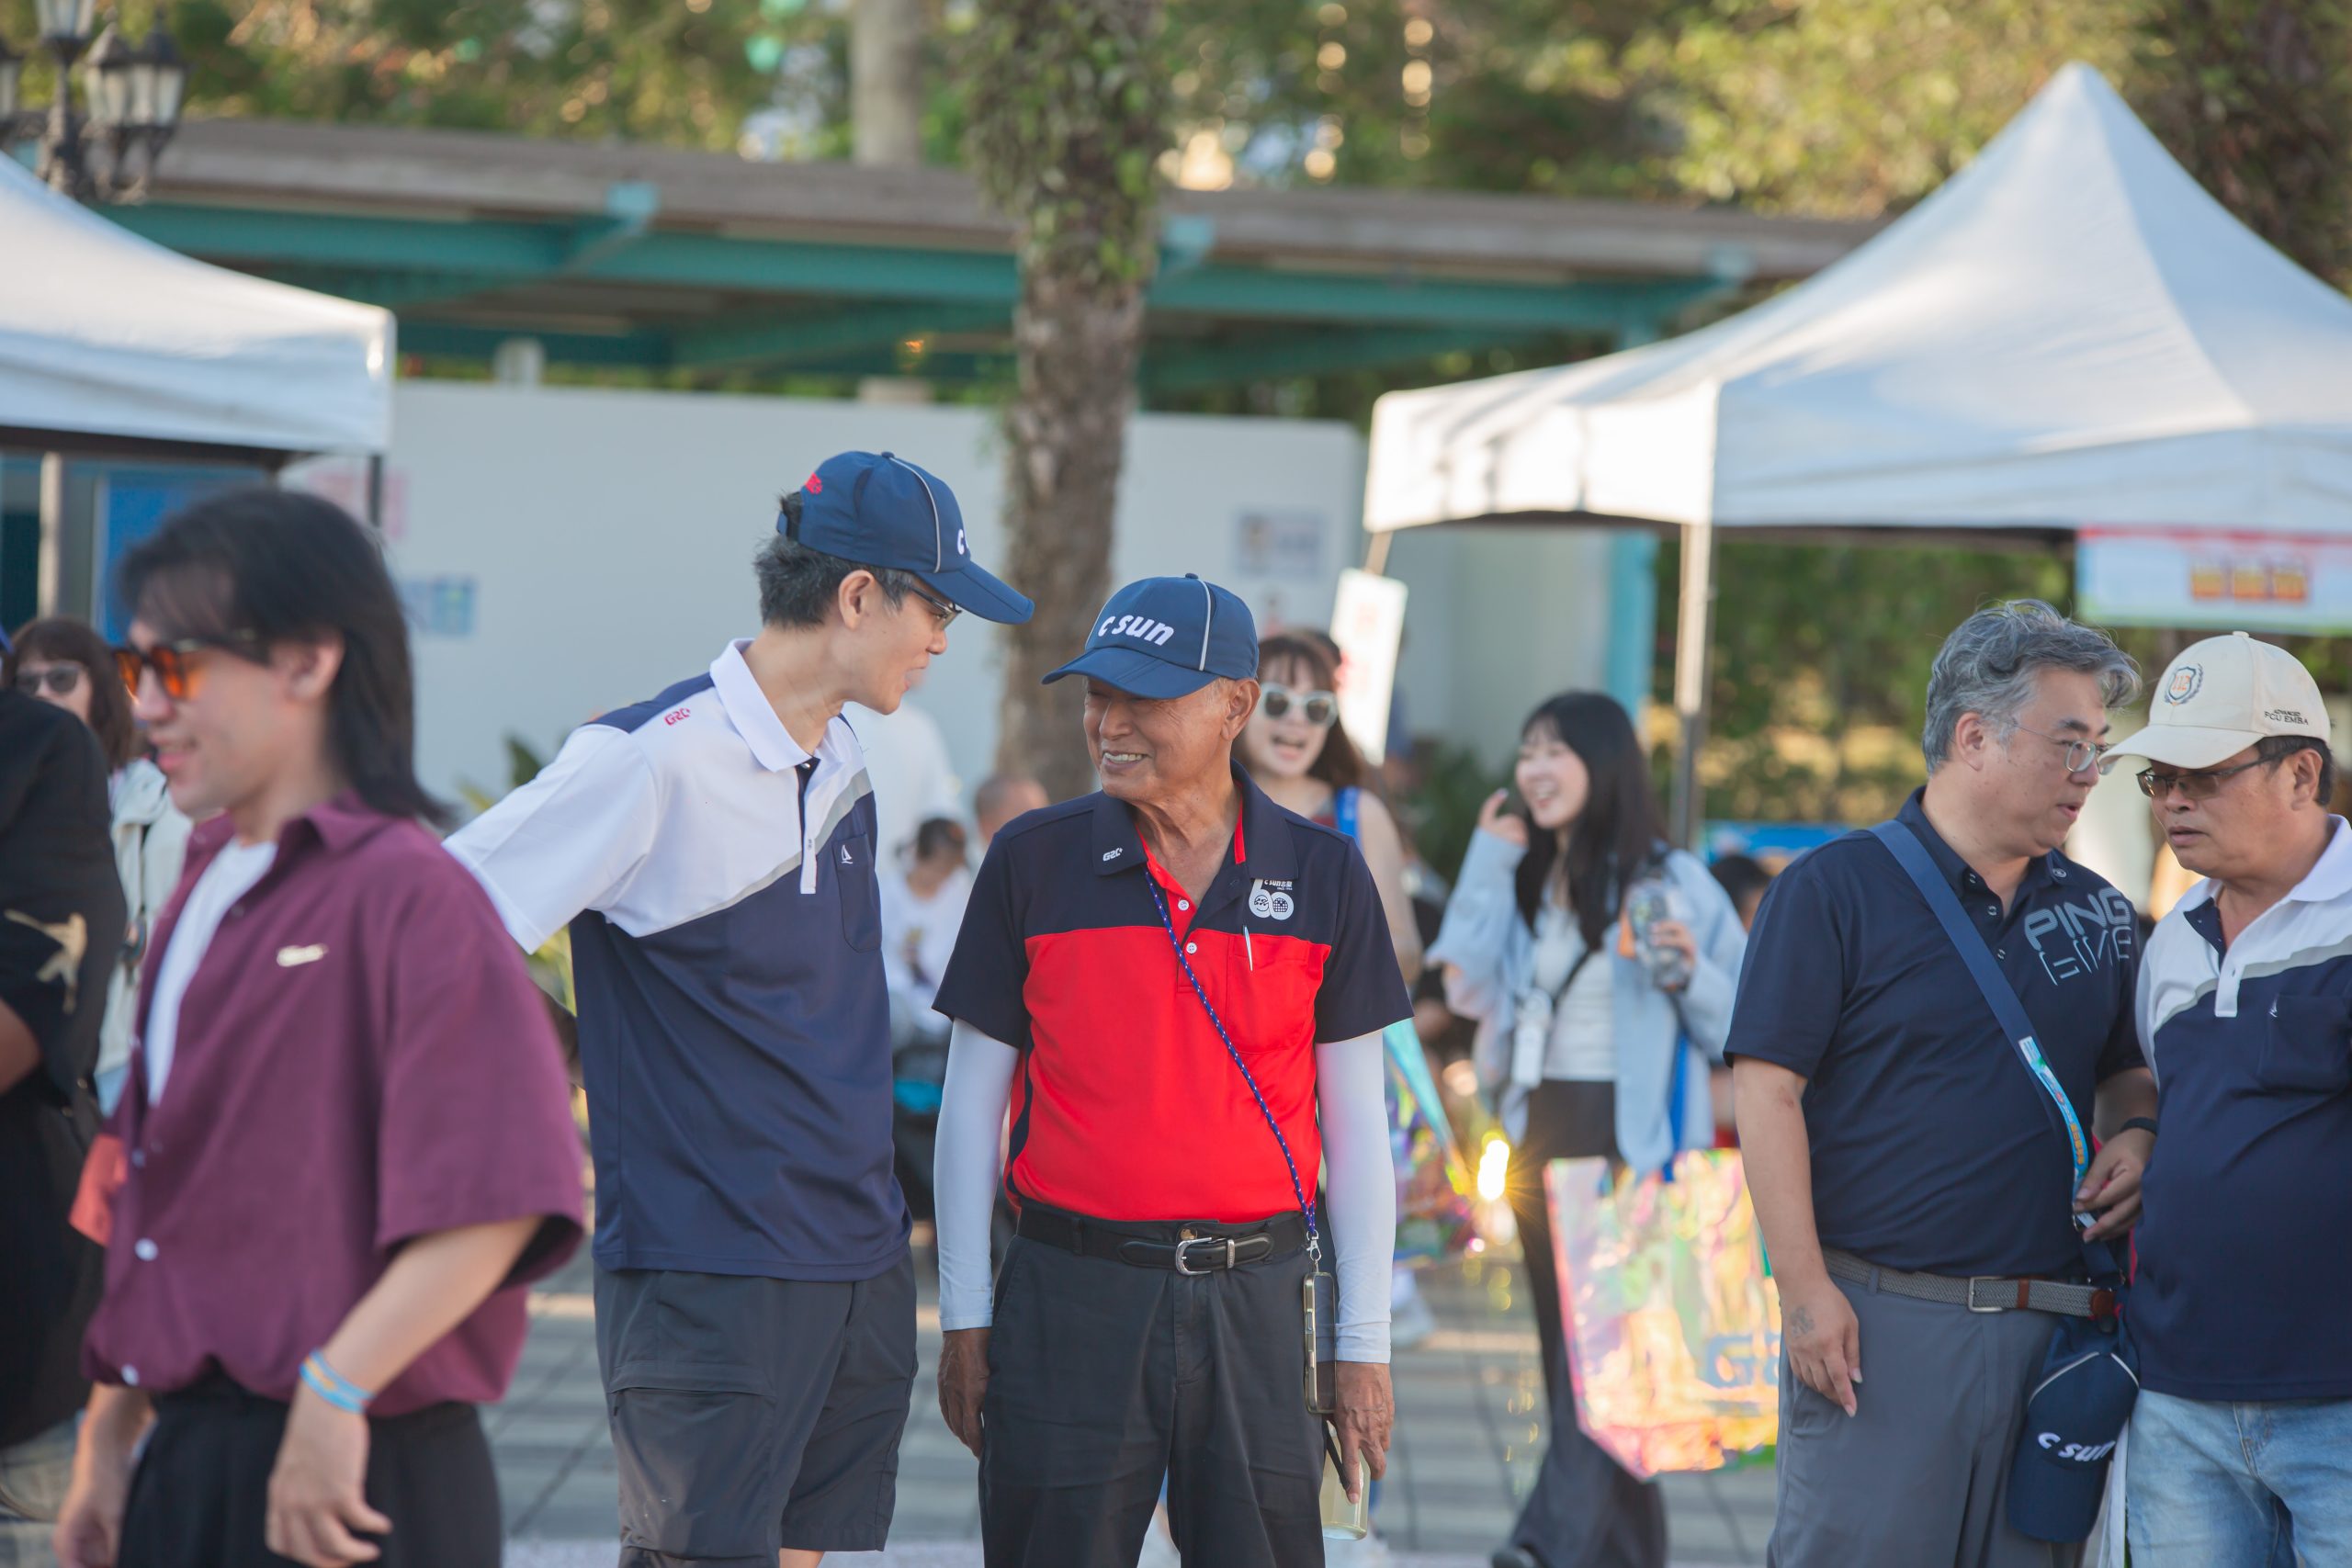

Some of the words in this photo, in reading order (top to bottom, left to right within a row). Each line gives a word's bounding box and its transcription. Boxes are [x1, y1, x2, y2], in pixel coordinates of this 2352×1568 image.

[2264, 711, 2282, 722] FCU
[2284, 716, 2309, 726] EMBA
[2024, 886, 2132, 951] PING
